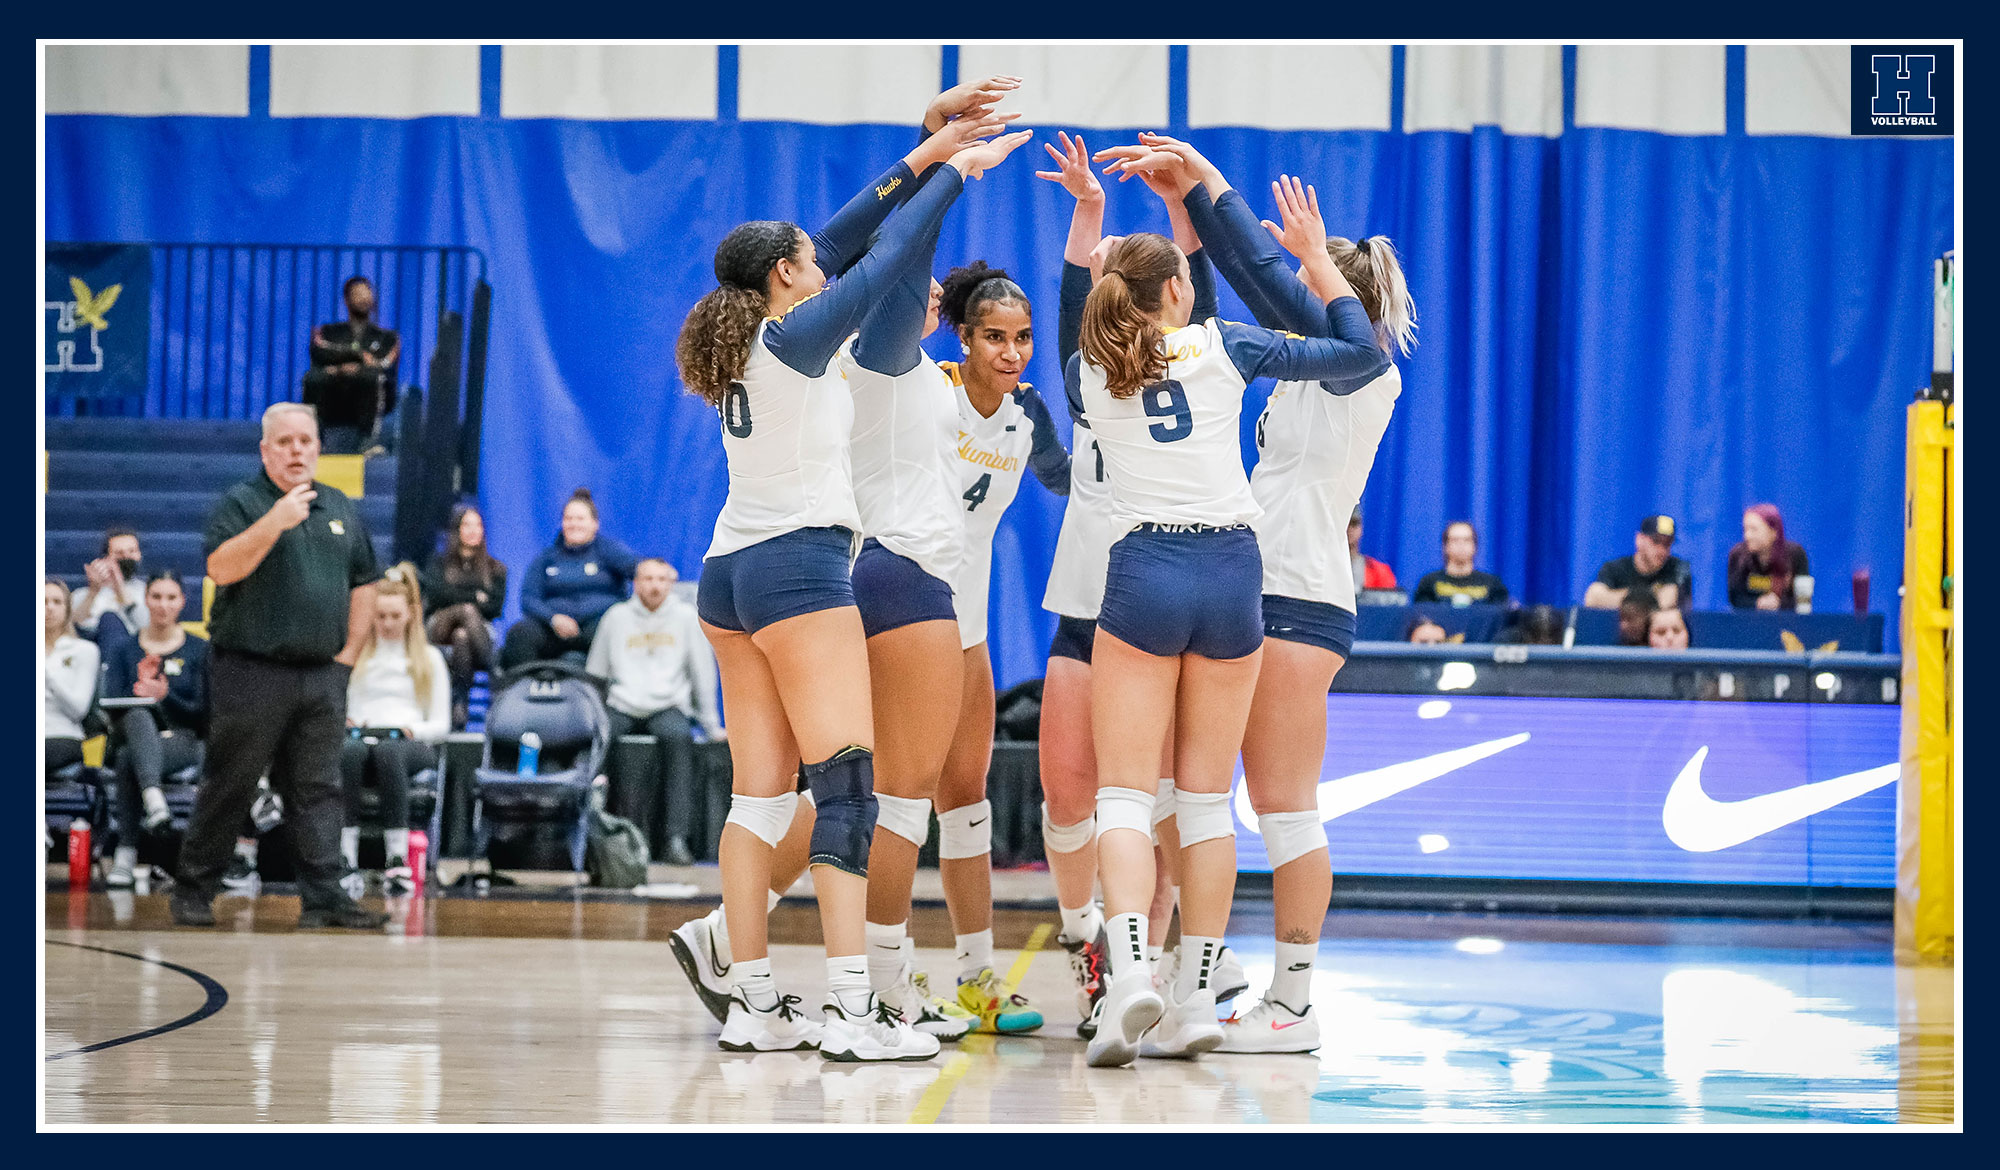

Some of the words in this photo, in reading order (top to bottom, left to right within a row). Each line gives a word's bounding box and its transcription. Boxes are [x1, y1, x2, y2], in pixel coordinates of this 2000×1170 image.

[875, 177, 902, 200] Hawks
[1142, 379, 1193, 443] 9
[1091, 439, 1110, 482] 1
[962, 472, 992, 512] 4
